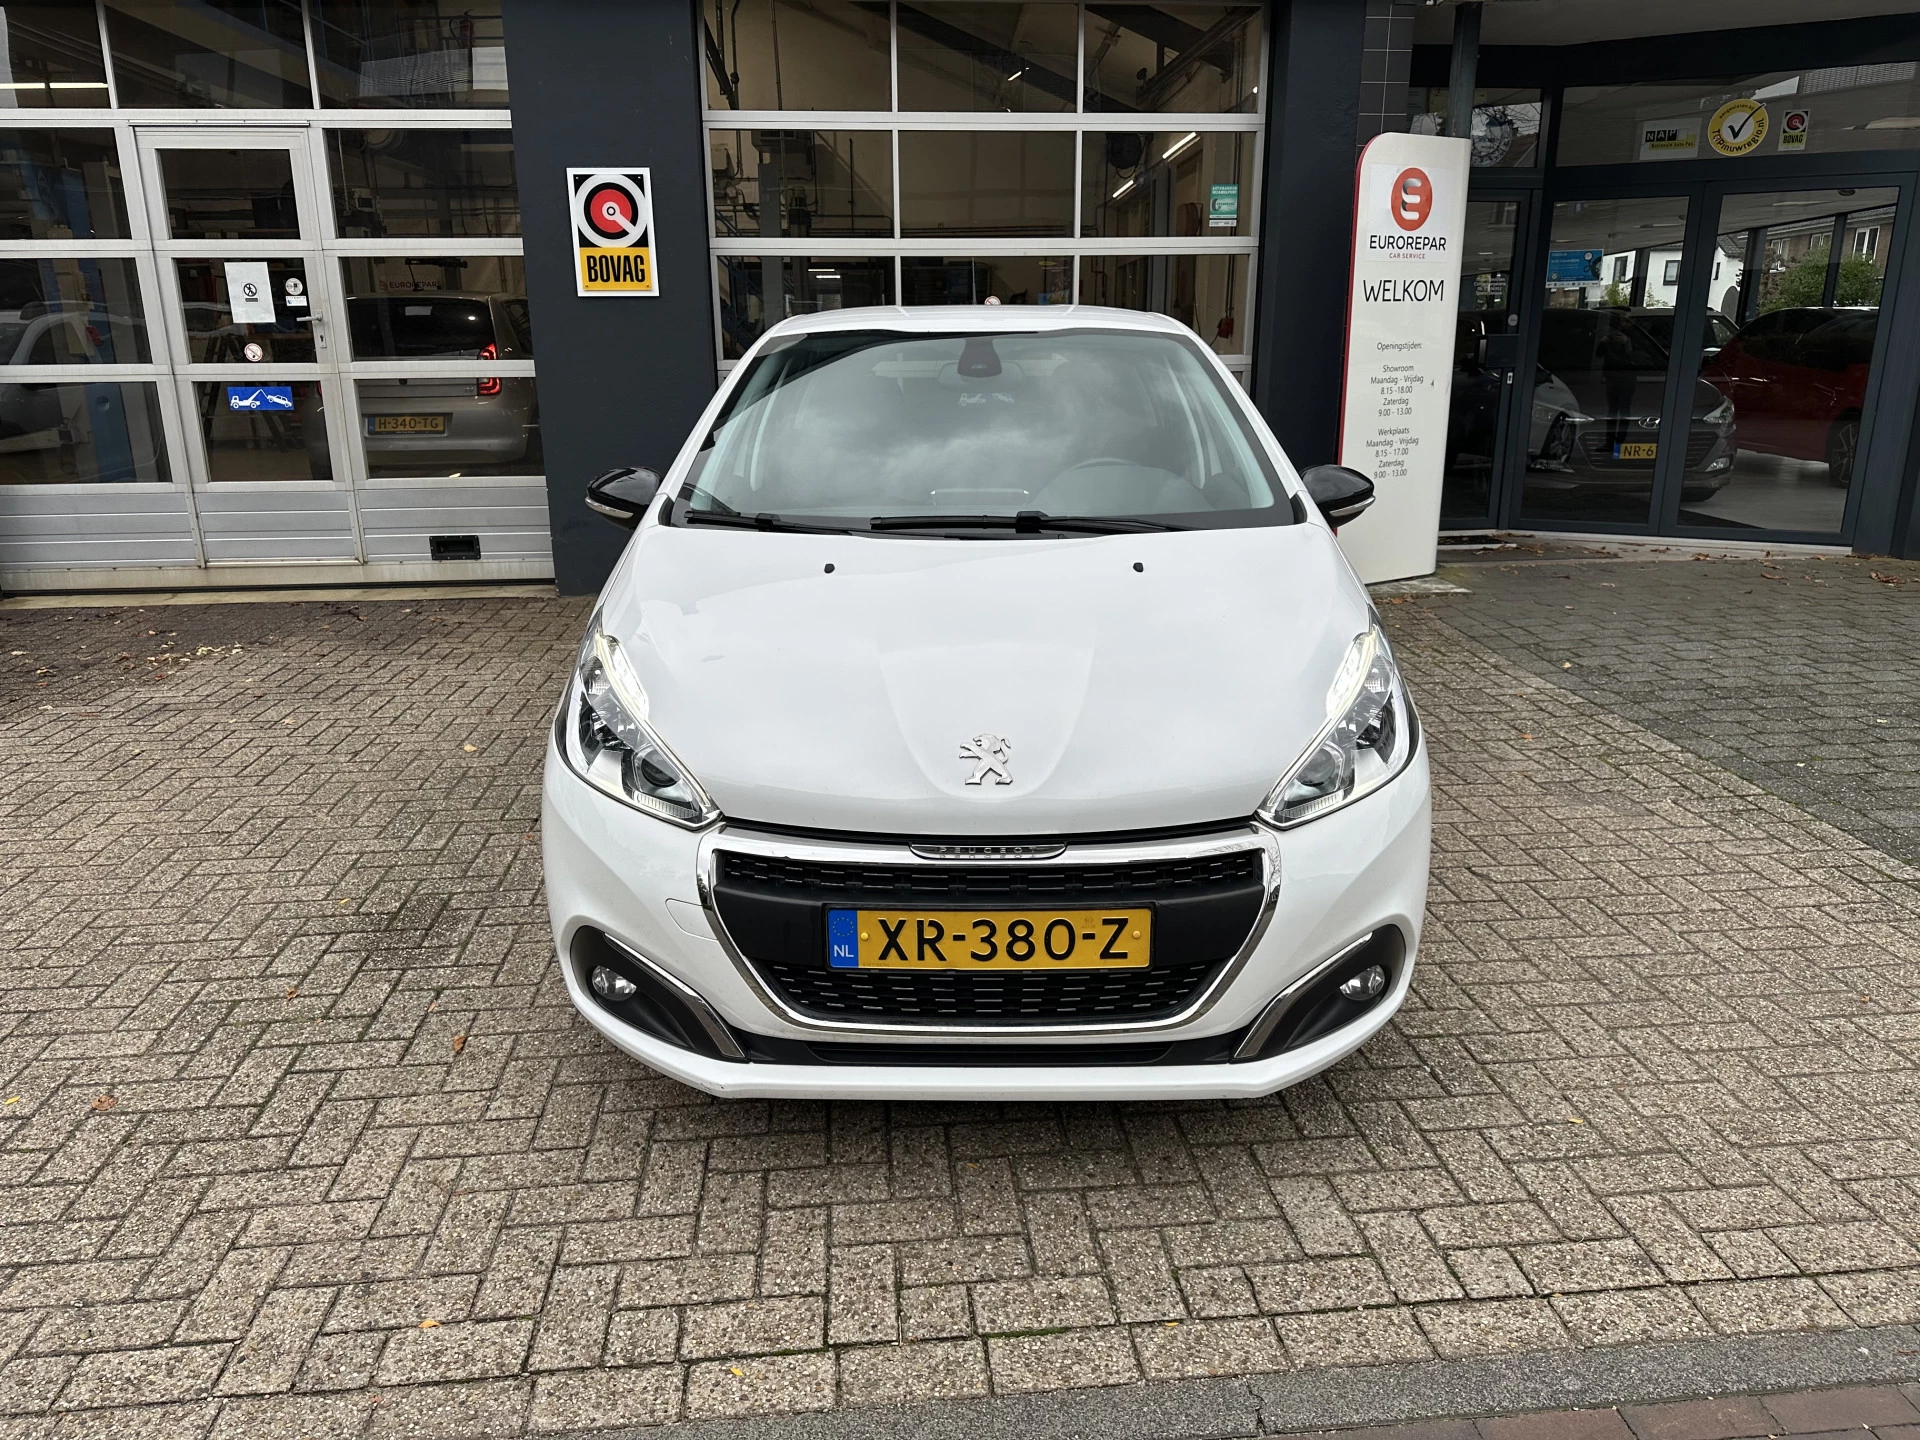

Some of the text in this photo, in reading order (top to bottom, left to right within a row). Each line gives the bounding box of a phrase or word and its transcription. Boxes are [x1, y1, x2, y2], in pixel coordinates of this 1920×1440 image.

[1646, 129, 1676, 140] NAP
[1782, 134, 1804, 144] BOVAG
[1369, 234, 1447, 251] EUROREPAR
[1402, 252, 1426, 260] SERVICE
[586, 254, 646, 283] BOVAG
[1363, 279, 1445, 302] WELKOM
[1376, 341, 1423, 352] Openingstijden:
[1382, 364, 1415, 373] Showroom
[1370, 376, 1398, 386] Maandag
[1403, 374, 1424, 385] Vrijdag
[1380, 386, 1393, 395] 8.15
[1382, 397, 1409, 407] Zaterdag
[1378, 408, 1391, 417] 9.00
[1396, 407, 1412, 416] 13.00
[378, 417, 439, 430] H-340-TG
[1377, 427, 1410, 436] Werkplaats
[1365, 438, 1393, 448] Maandag
[1399, 436, 1419, 446] Vrijdag
[1375, 449, 1388, 458] 8.15
[1393, 447, 1409, 456] 17.00
[1378, 459, 1405, 468] Zaterdag
[1373, 470, 1386, 479] 9.00
[1391, 468, 1408, 477] 13.00
[939, 846, 1037, 854] PEUGEOT
[877, 916, 1129, 962] XR-380-Z
[833, 944, 854, 958] NL
